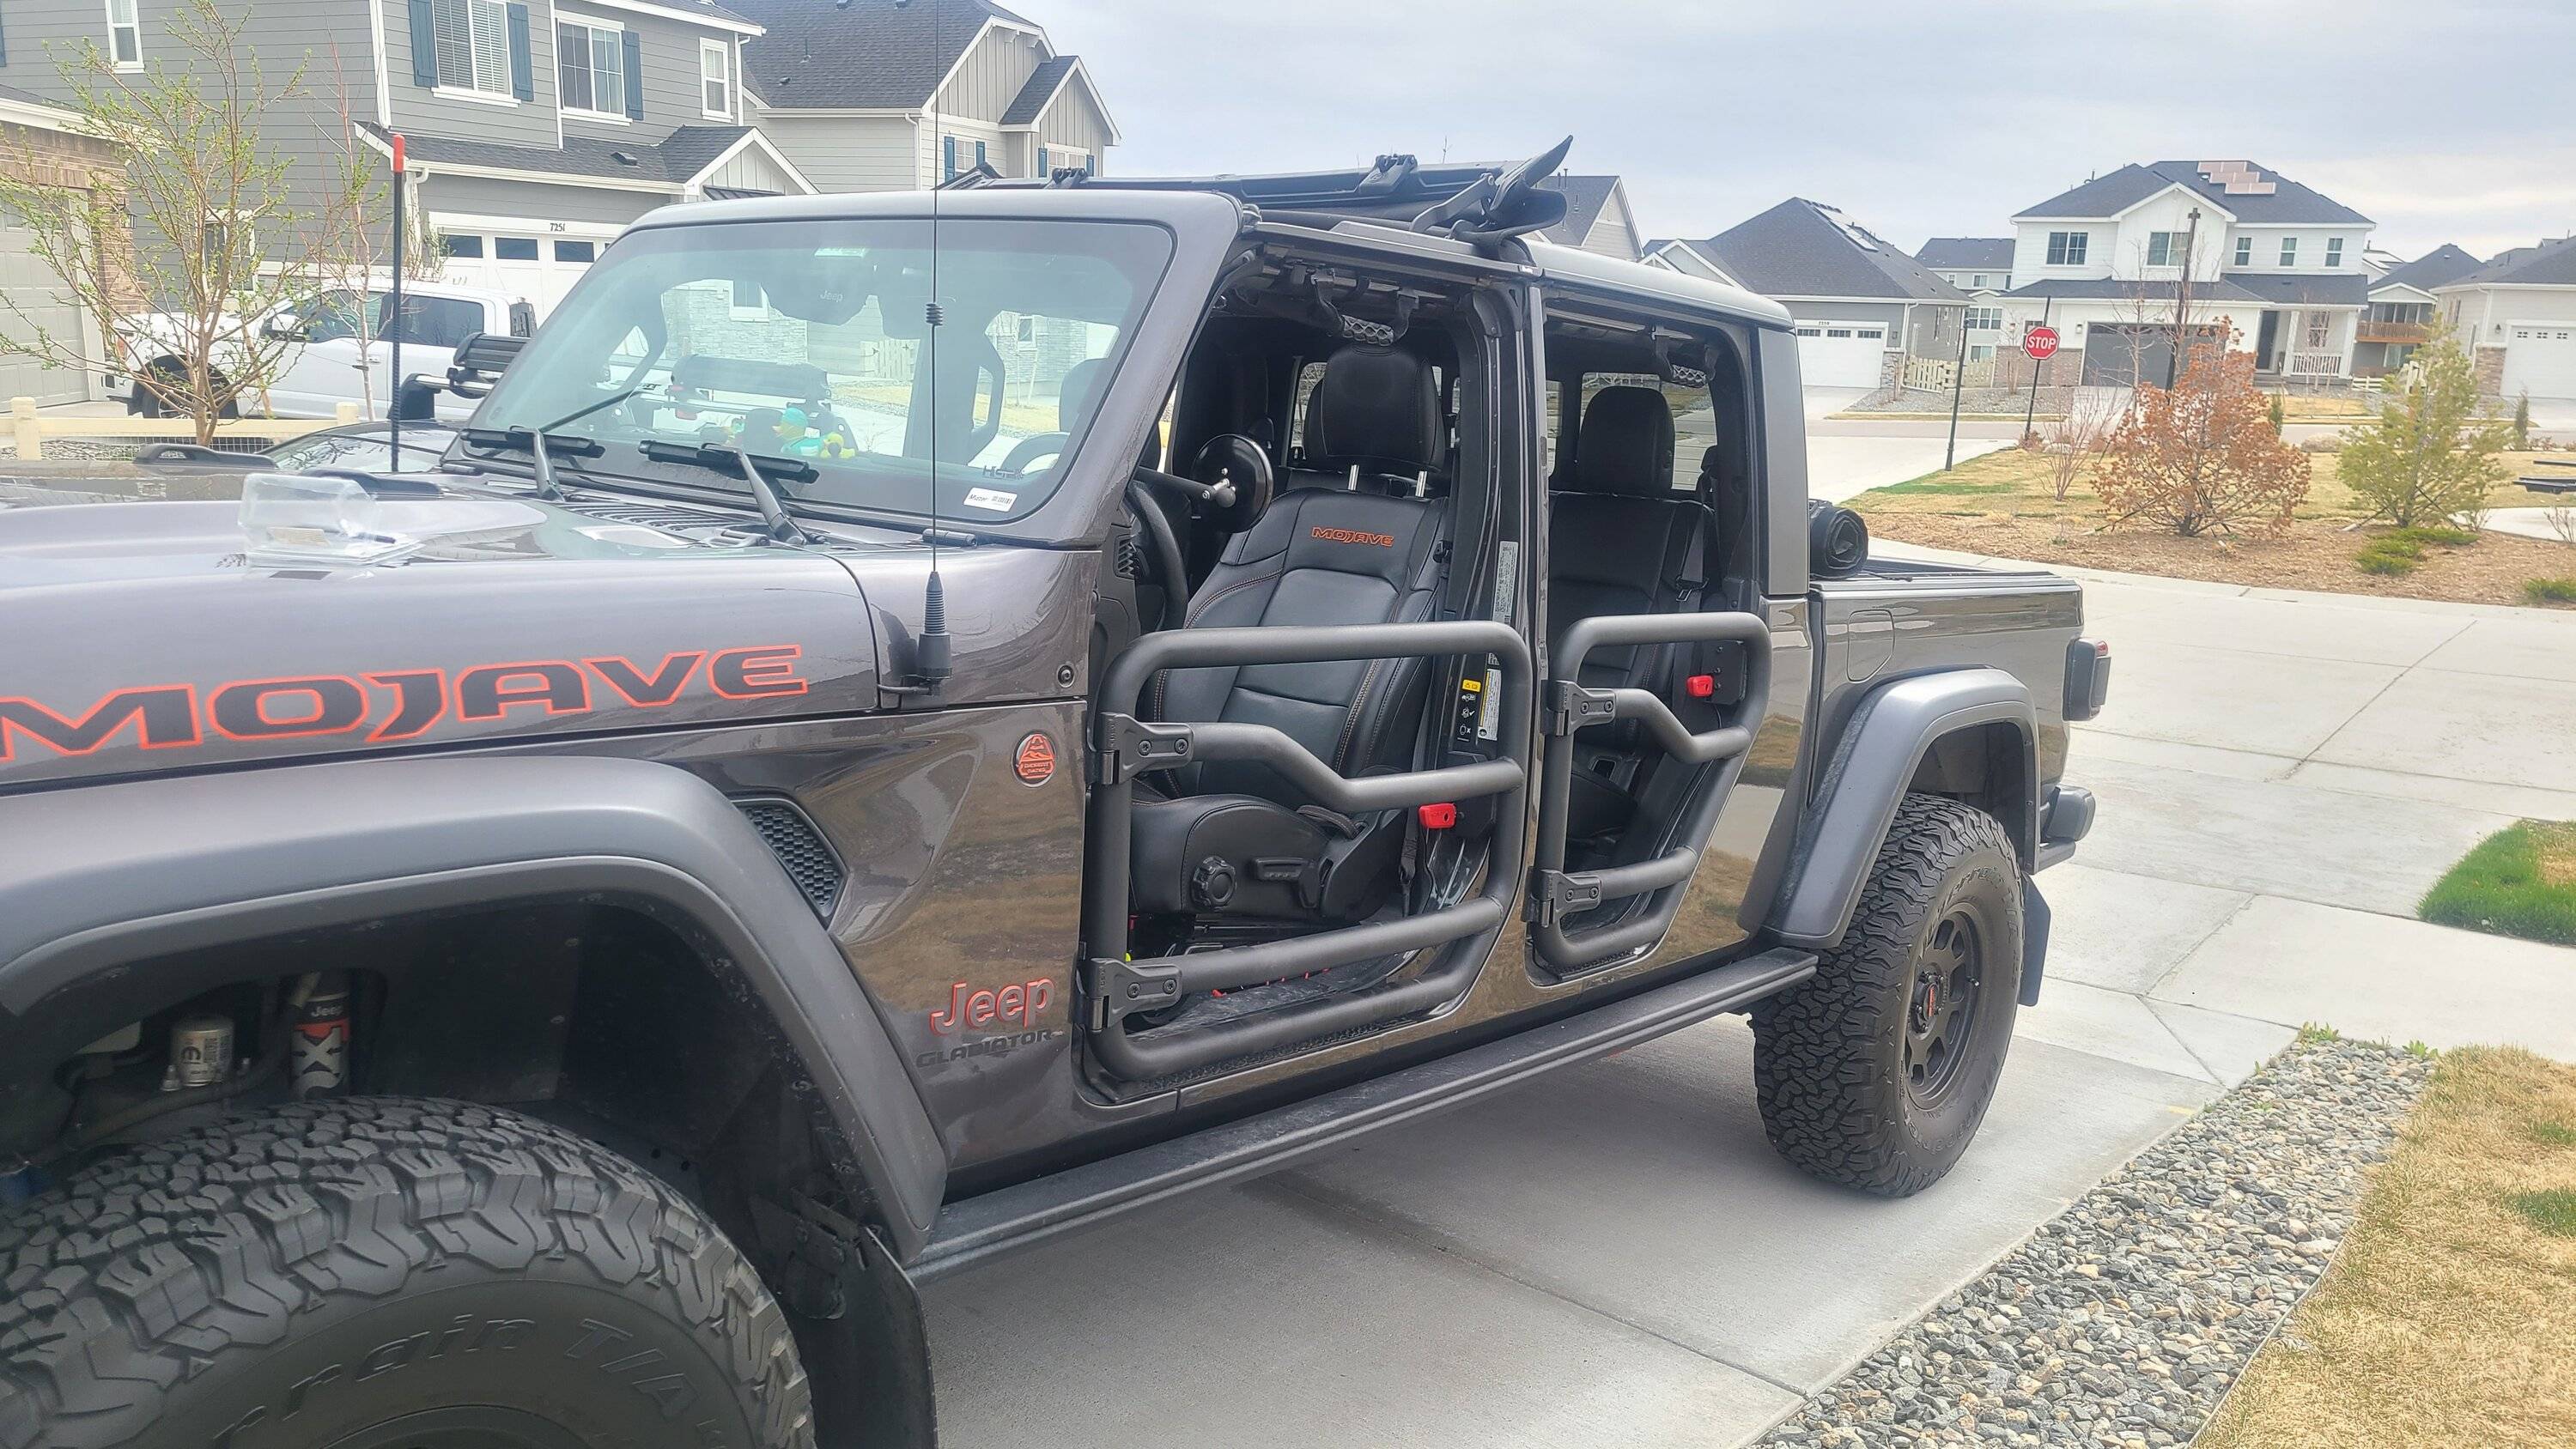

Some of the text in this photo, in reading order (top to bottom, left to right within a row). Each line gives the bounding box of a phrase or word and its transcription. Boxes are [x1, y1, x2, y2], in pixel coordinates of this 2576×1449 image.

[550, 222, 565, 232] 7251
[2027, 336, 2057, 350] STOP
[1311, 526, 1394, 547] MOJAVE
[0, 644, 808, 762] MOJAVE
[930, 977, 1055, 1036] Jeep
[915, 1029, 1064, 1069] GLADIATOR
